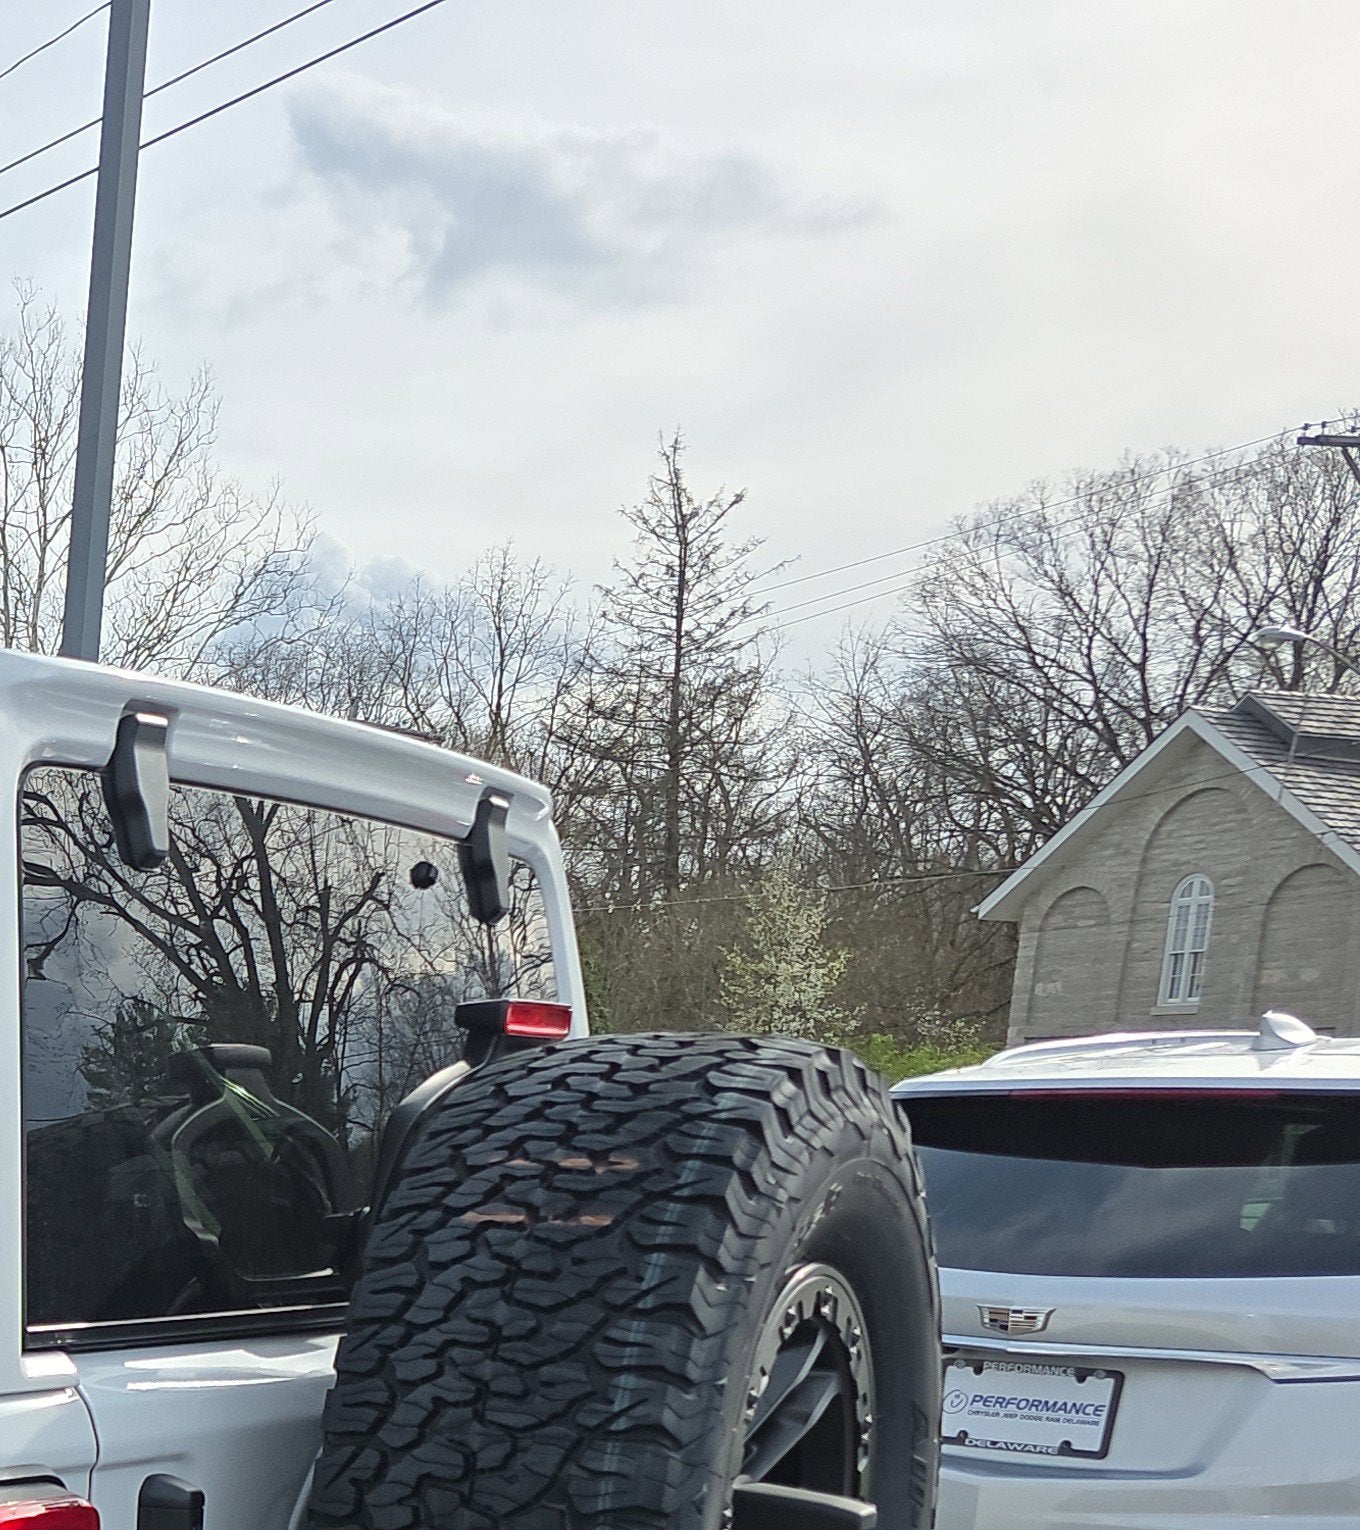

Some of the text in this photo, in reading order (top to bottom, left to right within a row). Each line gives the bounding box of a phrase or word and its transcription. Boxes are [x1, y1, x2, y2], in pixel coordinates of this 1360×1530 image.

[983, 1361, 1075, 1377] PERFORMANCE
[969, 1394, 1107, 1417] PERFORMANCE
[967, 1409, 1001, 1418] CHRYSLER
[1001, 1412, 1019, 1420] JEEP
[1020, 1413, 1044, 1422] DODGE
[1062, 1417, 1100, 1427] DELAWARE
[965, 1437, 1059, 1455] DELAWARE
